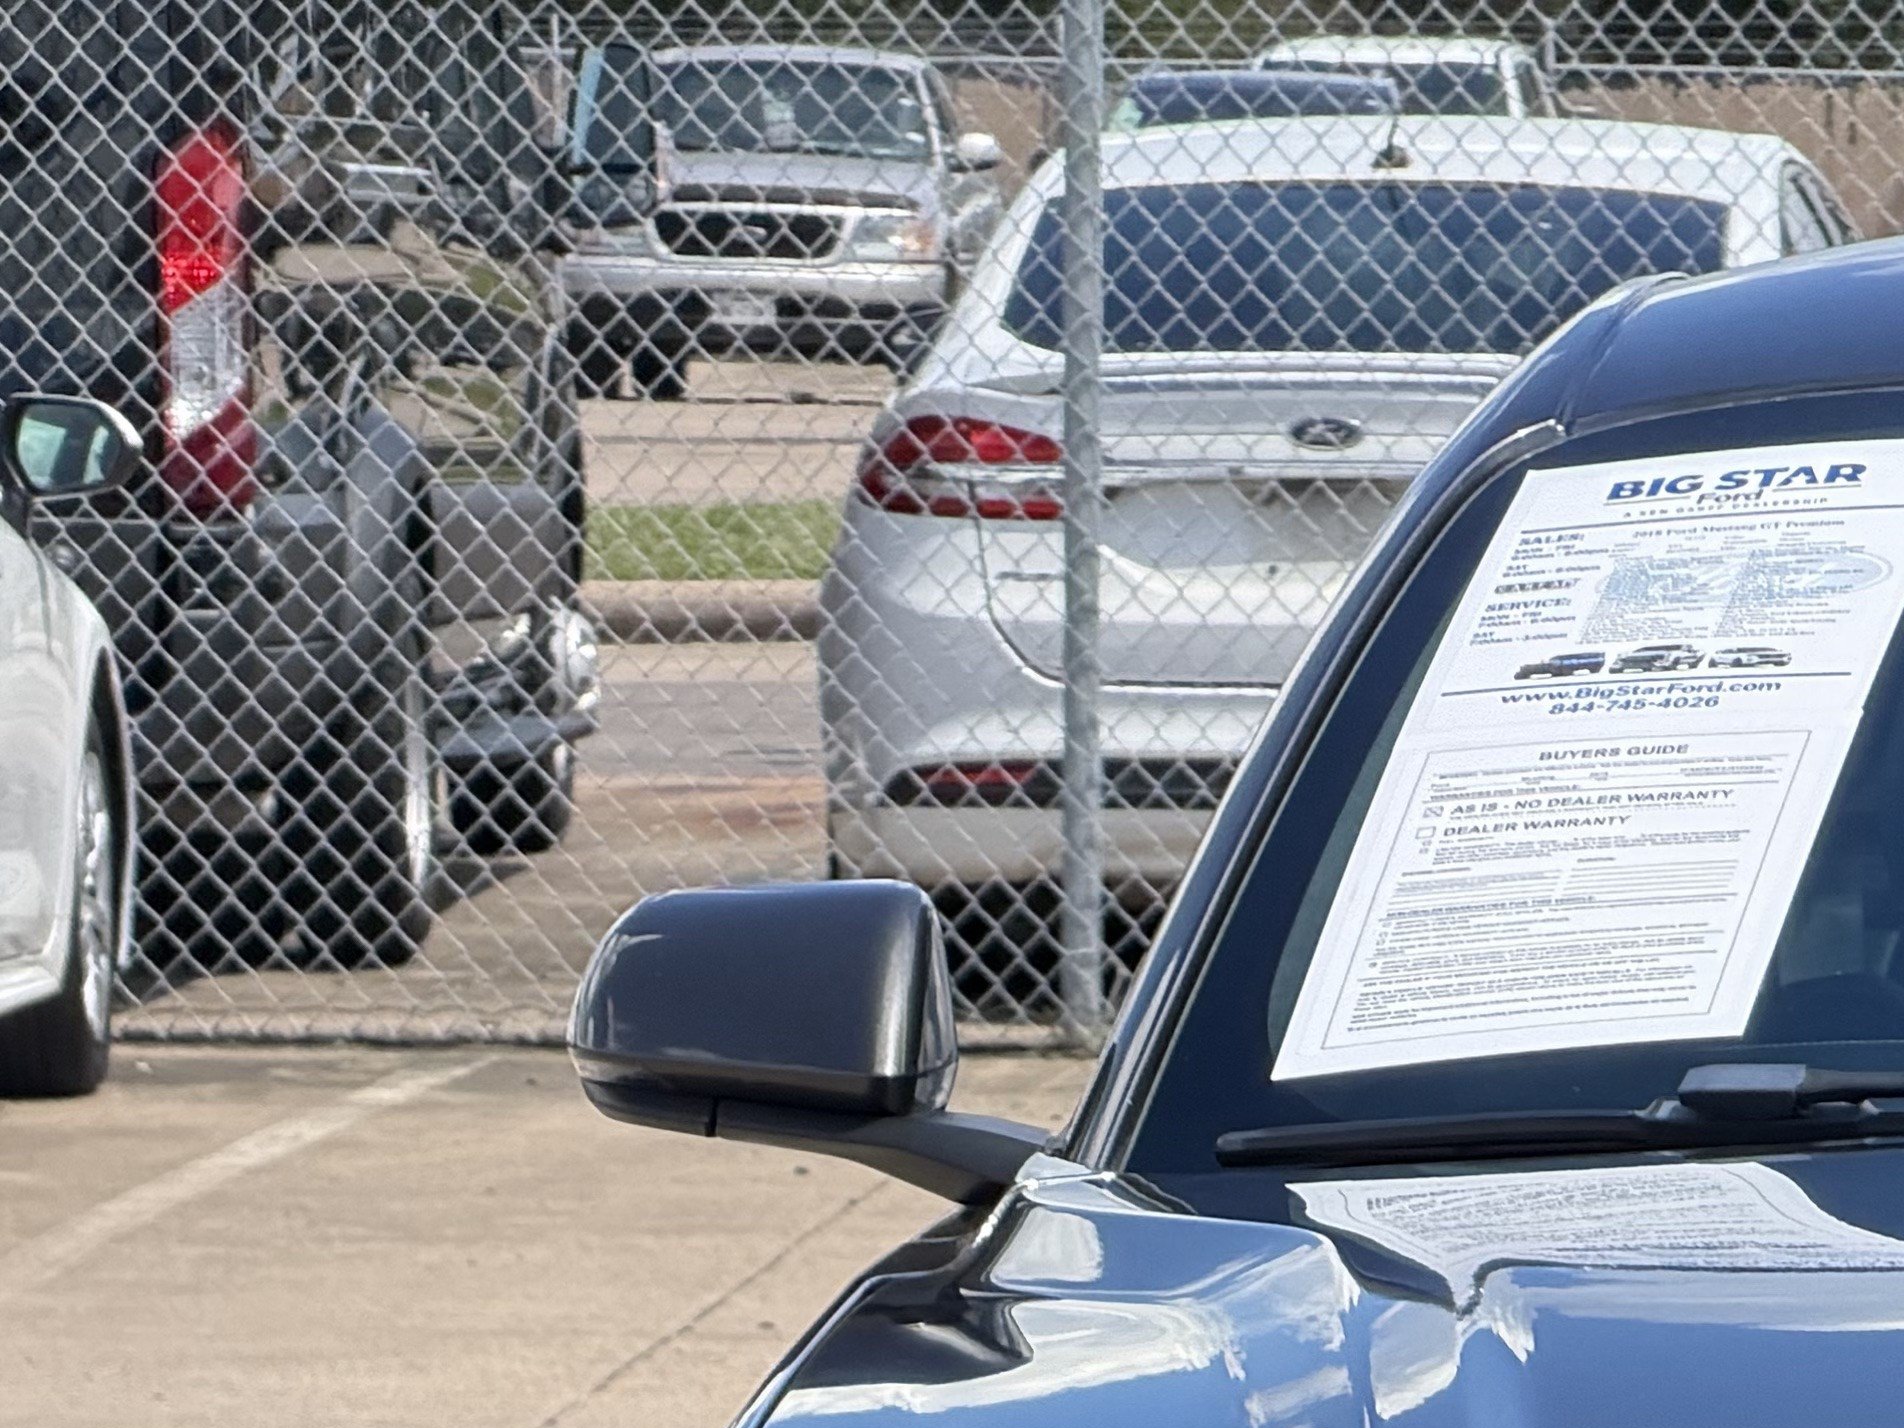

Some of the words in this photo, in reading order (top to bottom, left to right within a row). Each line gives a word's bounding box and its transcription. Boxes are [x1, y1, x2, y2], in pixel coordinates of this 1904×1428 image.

[1606, 474, 1704, 500] BIG
[1714, 463, 1867, 490] STAR
[1696, 488, 1764, 505] Ford
[1485, 598, 1572, 612] SERVICE:
[1501, 681, 1782, 704] www.BigStarFord.com
[1548, 696, 1720, 715] 844-745-4026
[1538, 747, 1620, 761] BUYERS
[1626, 744, 1690, 756] GUIDE
[1450, 804, 1477, 814] AS
[1480, 802, 1498, 813] IS
[1514, 799, 1542, 809] NO
[1547, 794, 1622, 807] DEALER
[1627, 788, 1735, 803] WARRANTY
[1443, 822, 1518, 837] DEALER
[1523, 815, 1632, 830] WARRANTY
